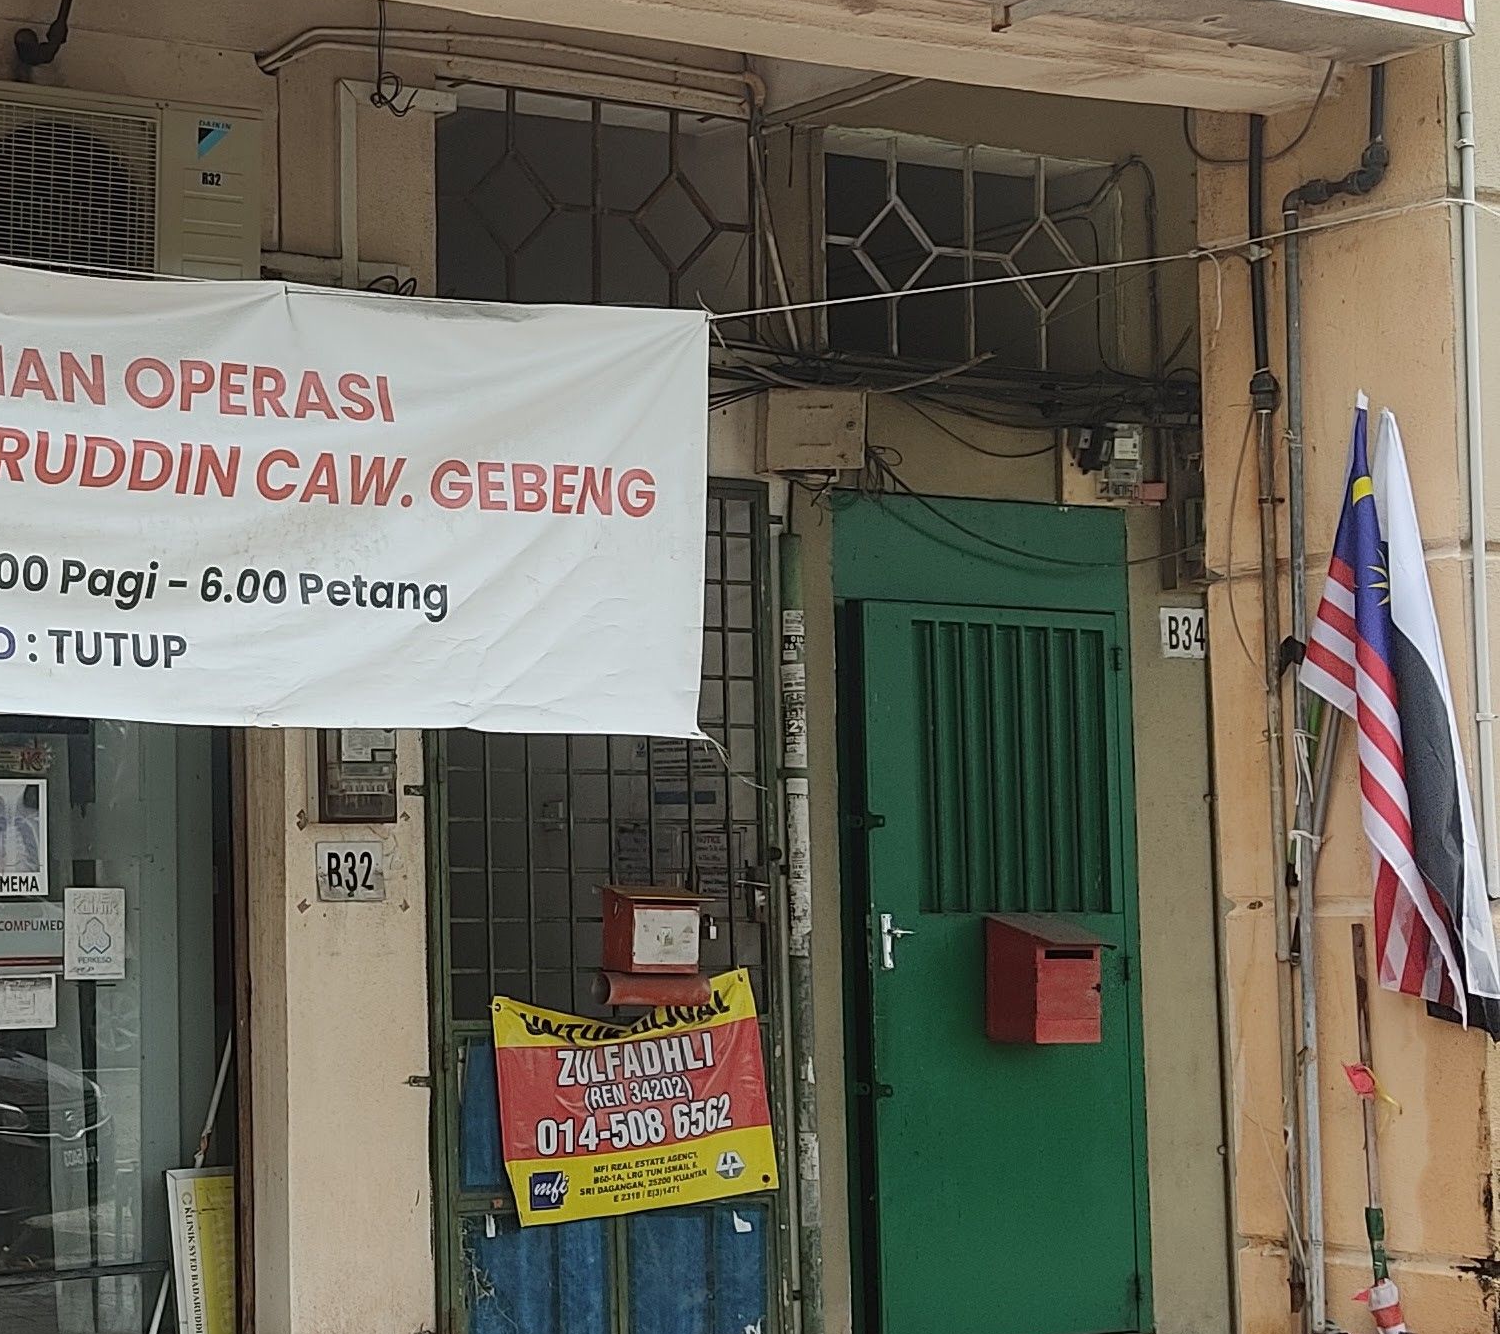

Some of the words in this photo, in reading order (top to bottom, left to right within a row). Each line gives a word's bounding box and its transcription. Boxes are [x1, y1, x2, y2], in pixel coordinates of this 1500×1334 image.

[199, 119, 233, 130] DAIKIN
[202, 172, 221, 186] R32
[123, 356, 396, 424] OPERASI
[255, 447, 414, 510] CAW.
[428, 458, 658, 519] GEBENG
[59, 558, 160, 611] Pagi
[199, 566, 289, 607] 6.00
[299, 572, 451, 623] Petang
[47, 628, 189, 671] TUTUP
[1168, 616, 1206, 651] B34
[327, 851, 374, 894] B32
[77, 956, 112, 964] PERKESO
[557, 1032, 715, 1086] ZULFADHLI
[584, 1083, 627, 1114] (REN
[629, 1075, 693, 1105] 34202)
[537, 1107, 666, 1155] 014-508
[672, 1093, 733, 1140] 6562
[611, 1161, 633, 1171] REAL
[635, 1157, 666, 1168] ESTATE
[645, 1166, 664, 1177] TUN
[534, 1172, 569, 1205] mfi
[579, 1186, 596, 1196] SRI
[672, 1168, 708, 1183] KUANTAN
[613, 1194, 620, 1203] E
[184, 1207, 196, 1245] KLINIK
[188, 1246, 199, 1272] SYED
